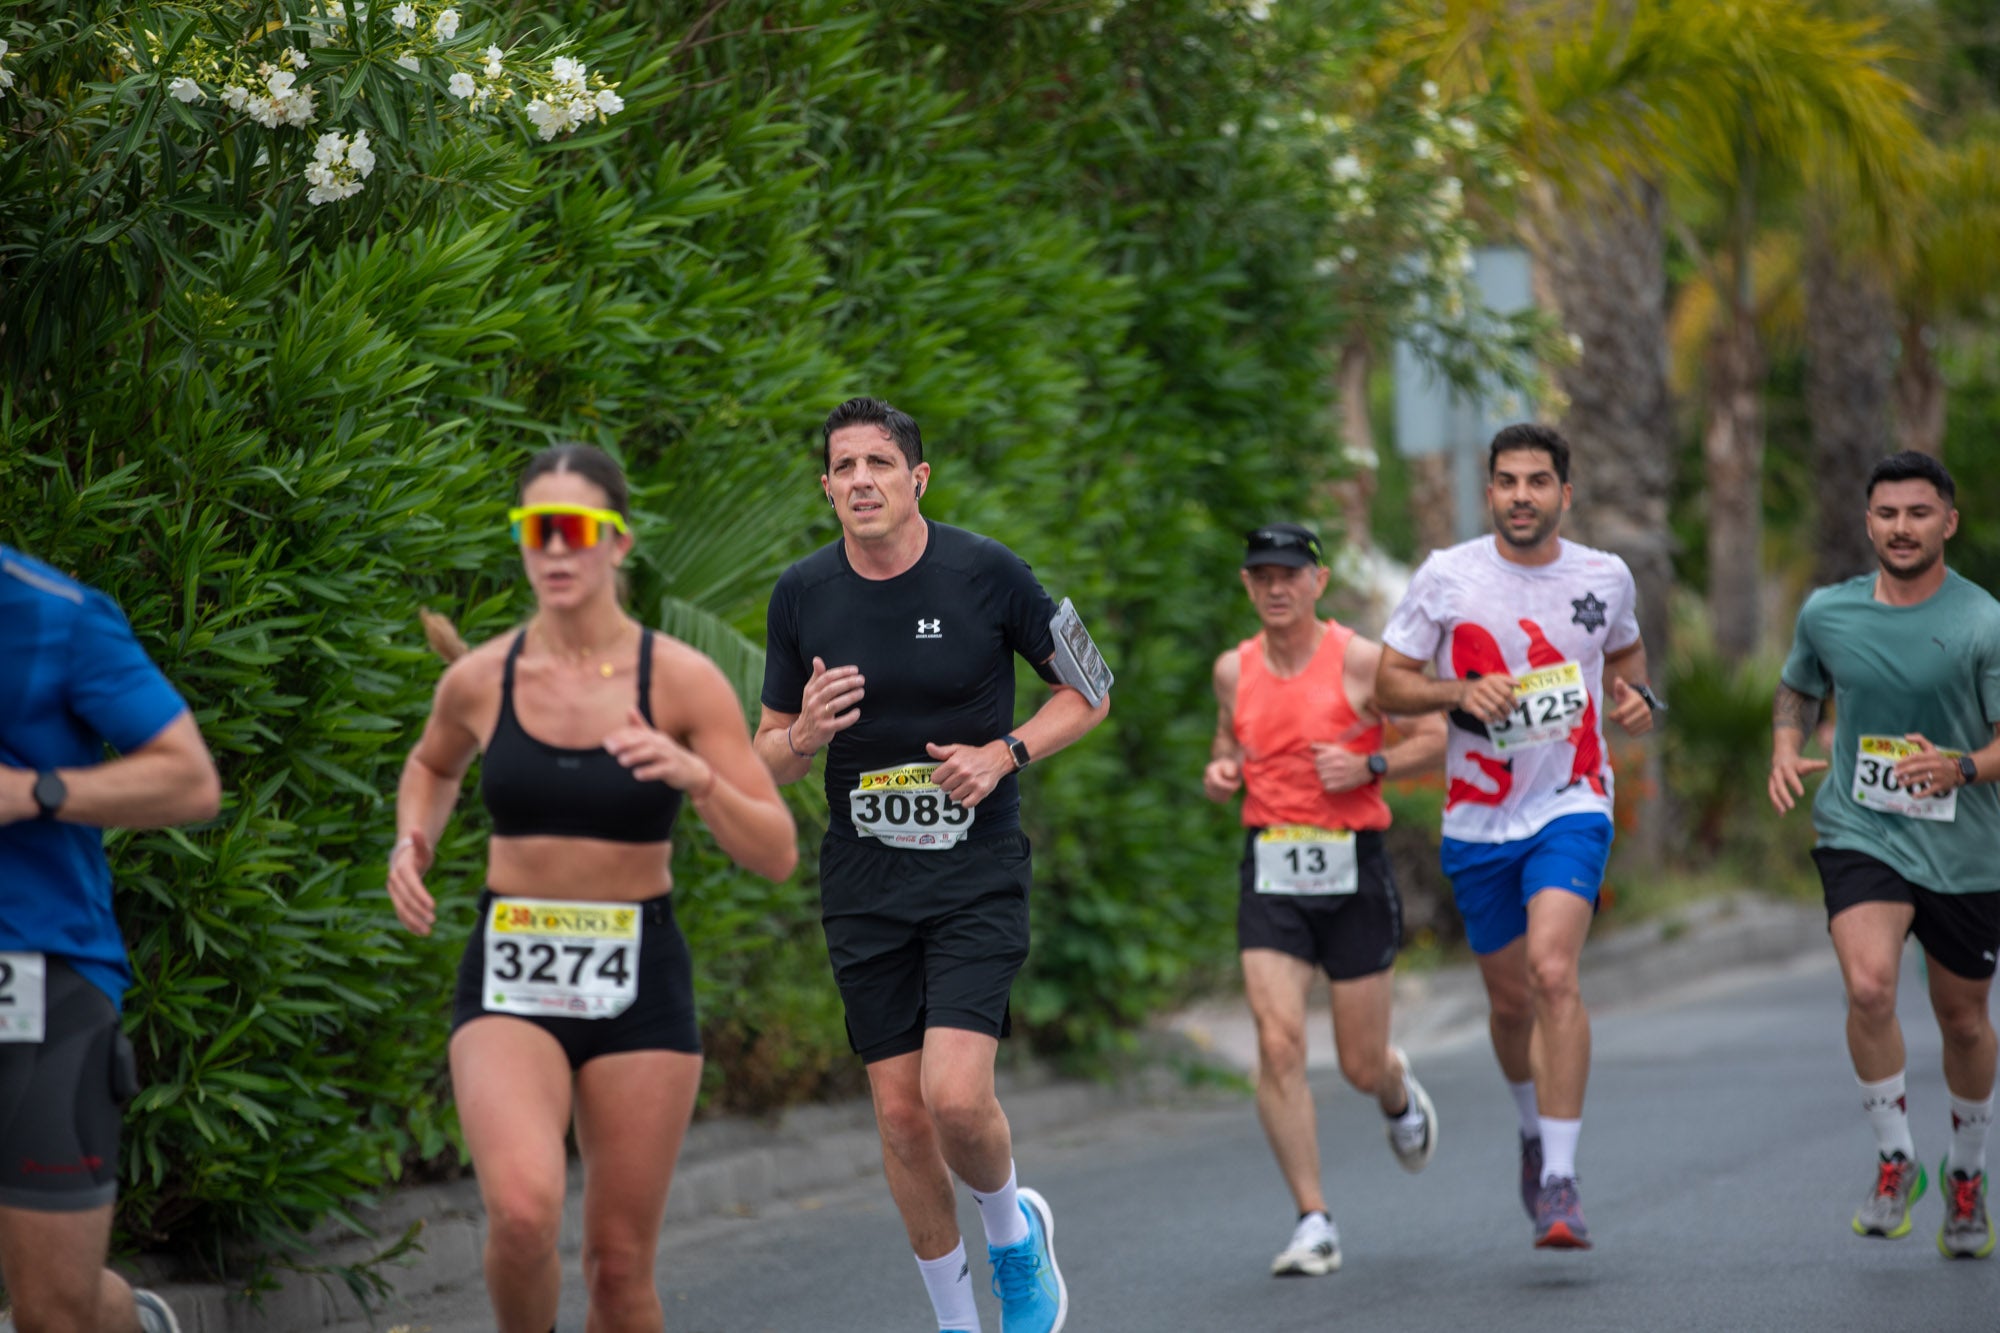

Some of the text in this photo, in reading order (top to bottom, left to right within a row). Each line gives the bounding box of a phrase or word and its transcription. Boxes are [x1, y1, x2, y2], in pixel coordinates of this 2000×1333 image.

[886, 774, 931, 787] OND
[912, 766, 936, 776] PREMI
[1860, 759, 1952, 799] 30
[855, 794, 969, 826] 3085
[1285, 847, 1327, 874] 13
[493, 941, 630, 988] 3274
